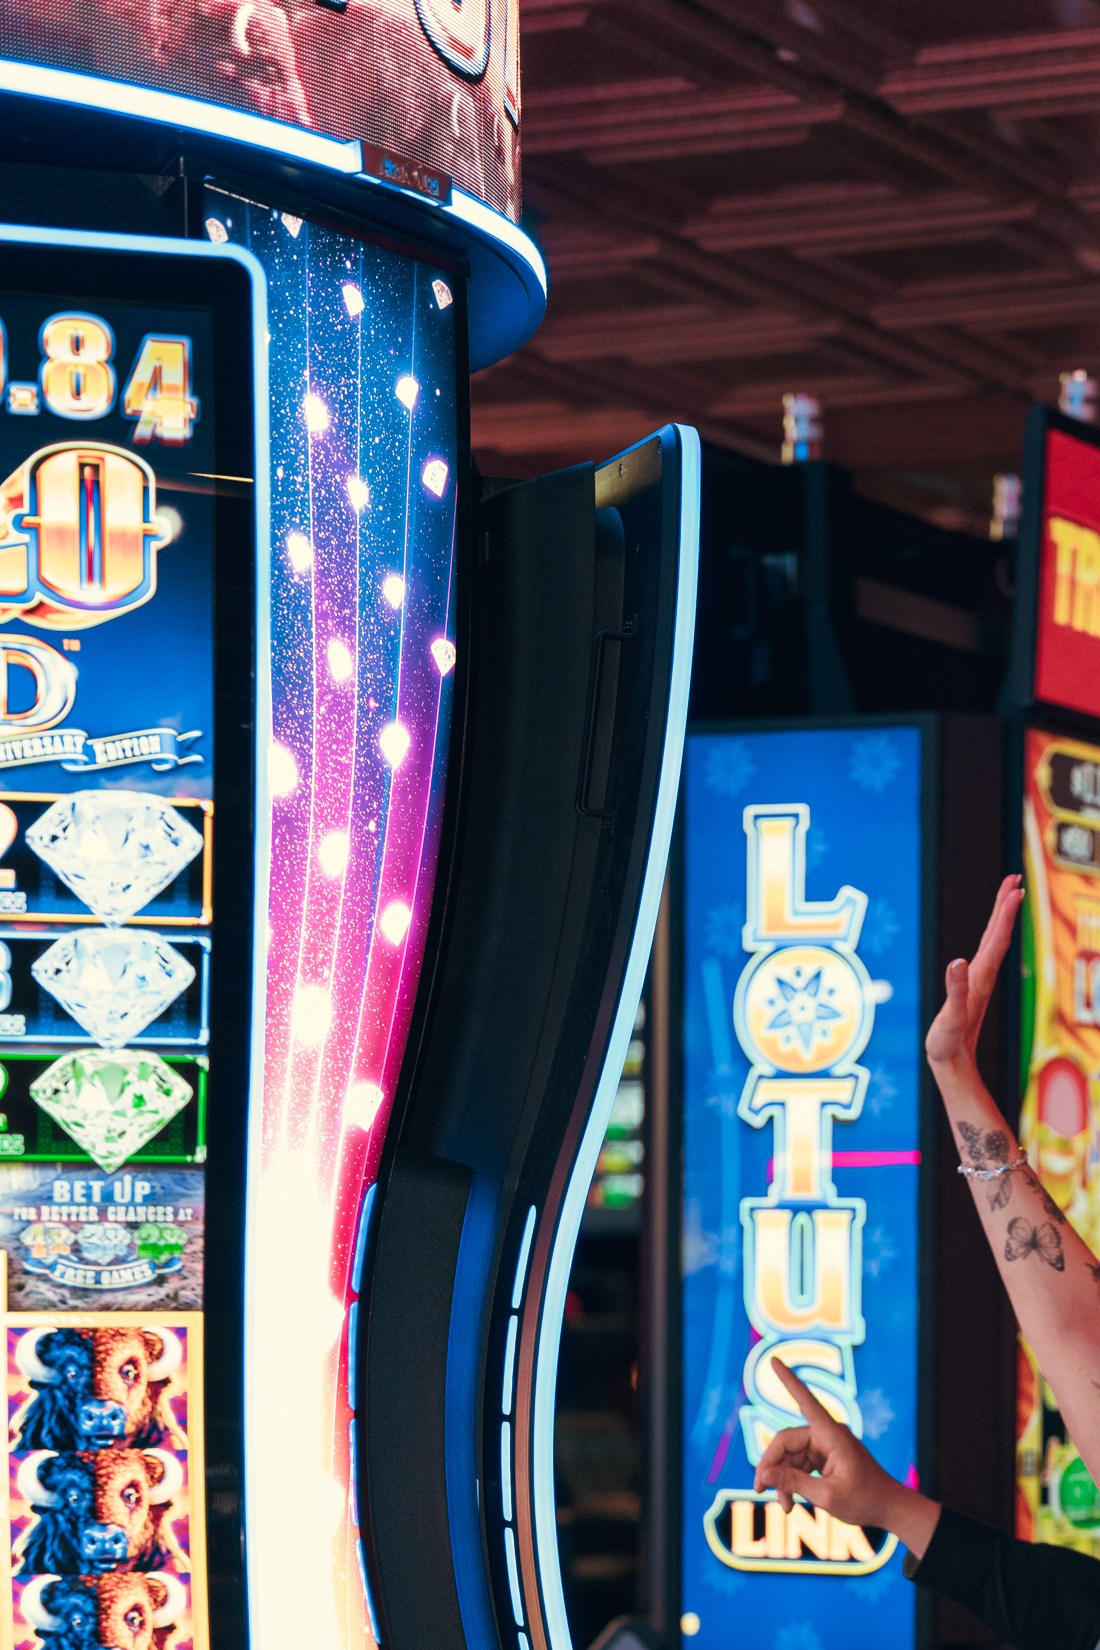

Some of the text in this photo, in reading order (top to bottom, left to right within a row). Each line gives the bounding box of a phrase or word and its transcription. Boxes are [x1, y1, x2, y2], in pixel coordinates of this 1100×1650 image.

[93, 734, 161, 771] EDITION
[53, 1174, 151, 1203] BET UP
[40, 1206, 99, 1222] BETTER
[177, 1208, 193, 1221] AT
[54, 1263, 152, 1284] FREE GAMES
